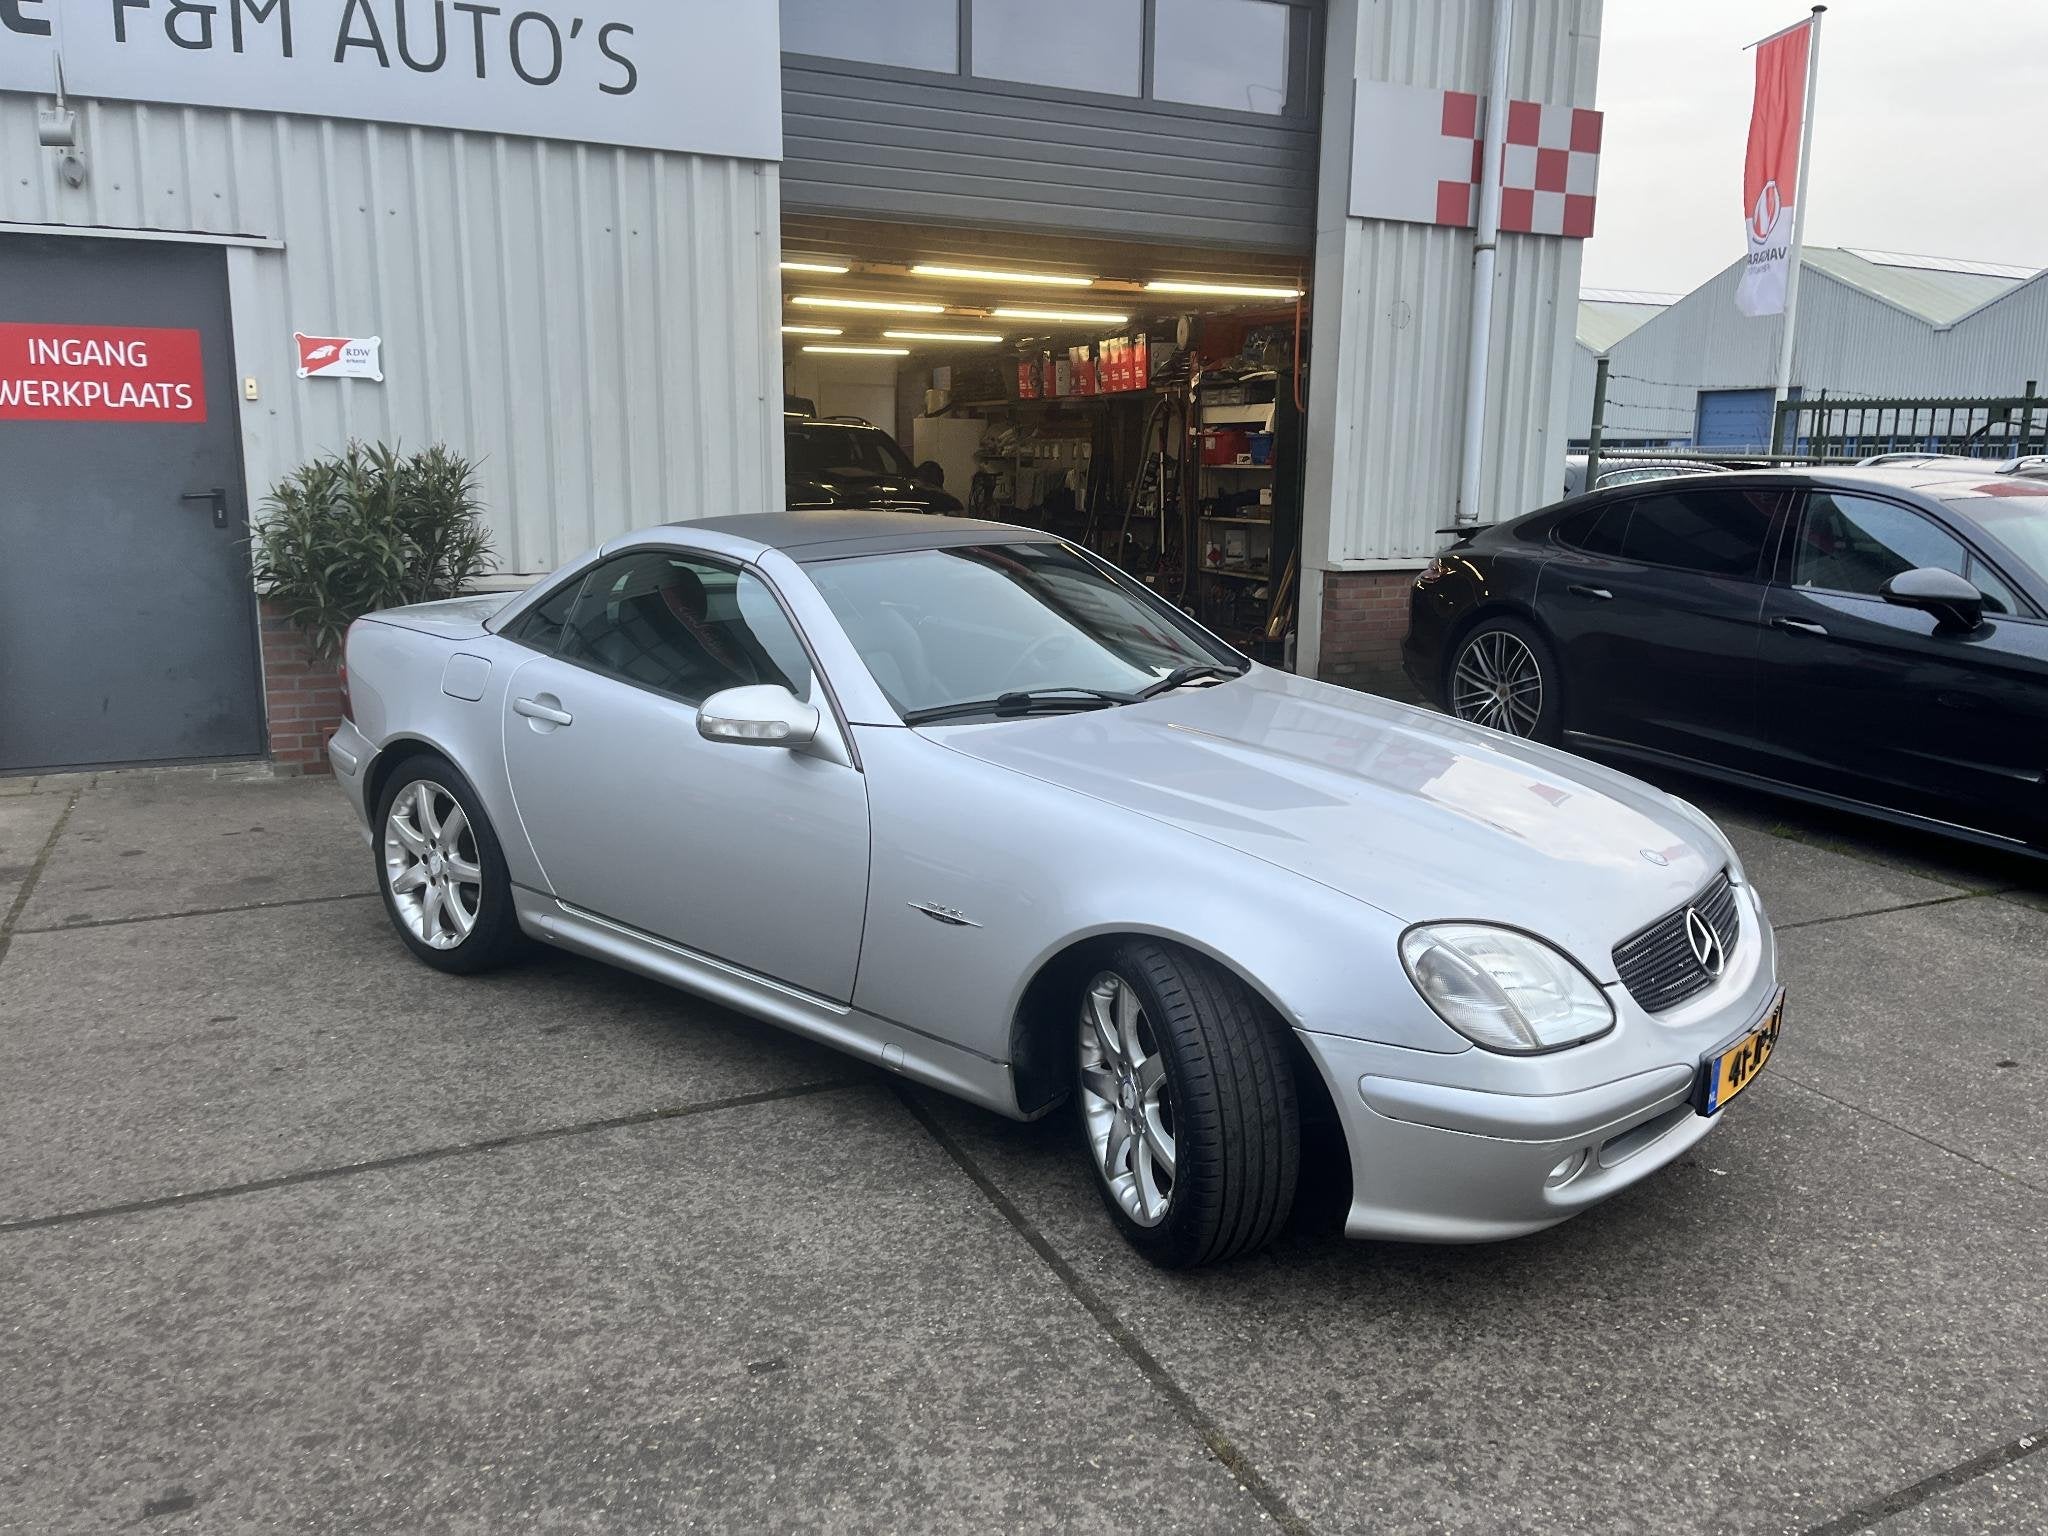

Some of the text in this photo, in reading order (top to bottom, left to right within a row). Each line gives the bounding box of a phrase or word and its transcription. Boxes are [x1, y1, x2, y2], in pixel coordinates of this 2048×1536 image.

[333, 0, 639, 96] AUTO'S
[28, 338, 149, 368] INGANG
[346, 348, 370, 356] RDW
[0, 379, 193, 410] WERKPLAATS
